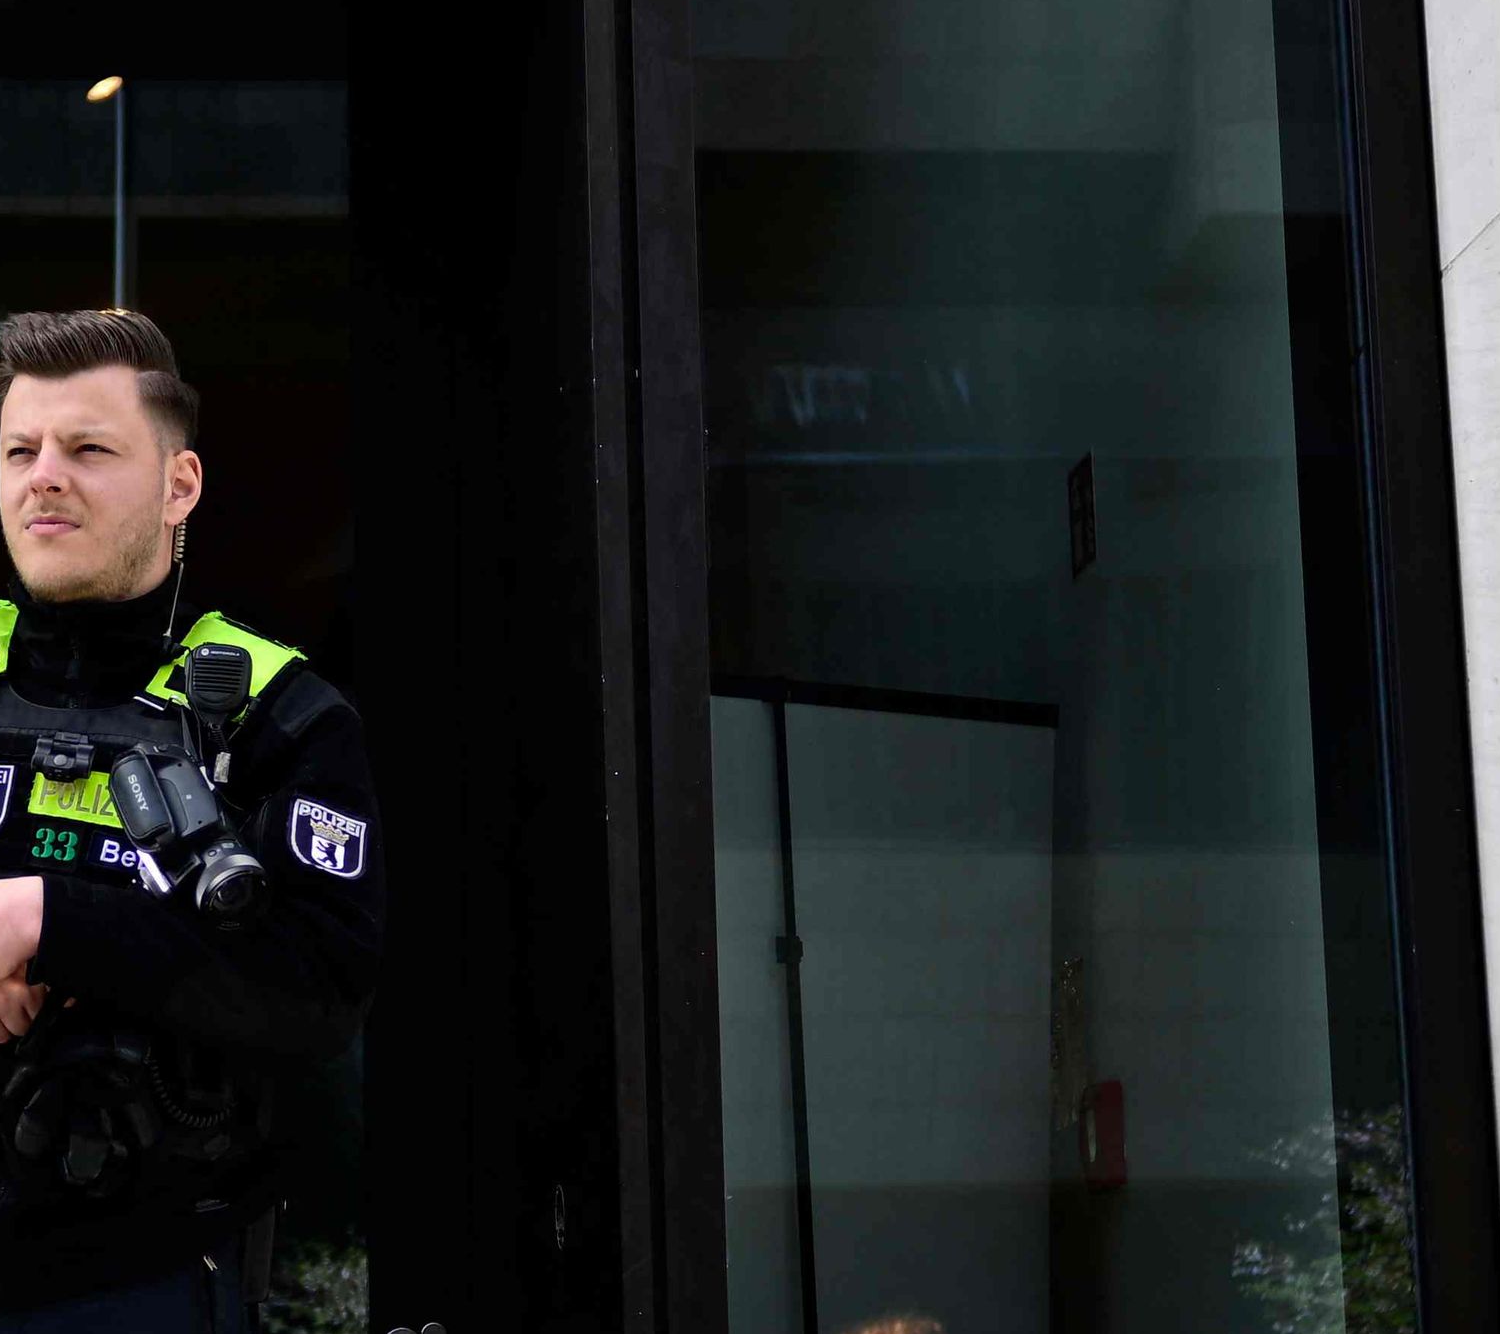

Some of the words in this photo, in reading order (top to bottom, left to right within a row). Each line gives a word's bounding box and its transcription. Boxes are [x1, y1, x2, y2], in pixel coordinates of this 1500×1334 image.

[39, 778, 114, 816] POLIZ
[128, 774, 149, 811] SONY
[299, 803, 360, 838] POLIZEI
[31, 828, 78, 862] 33
